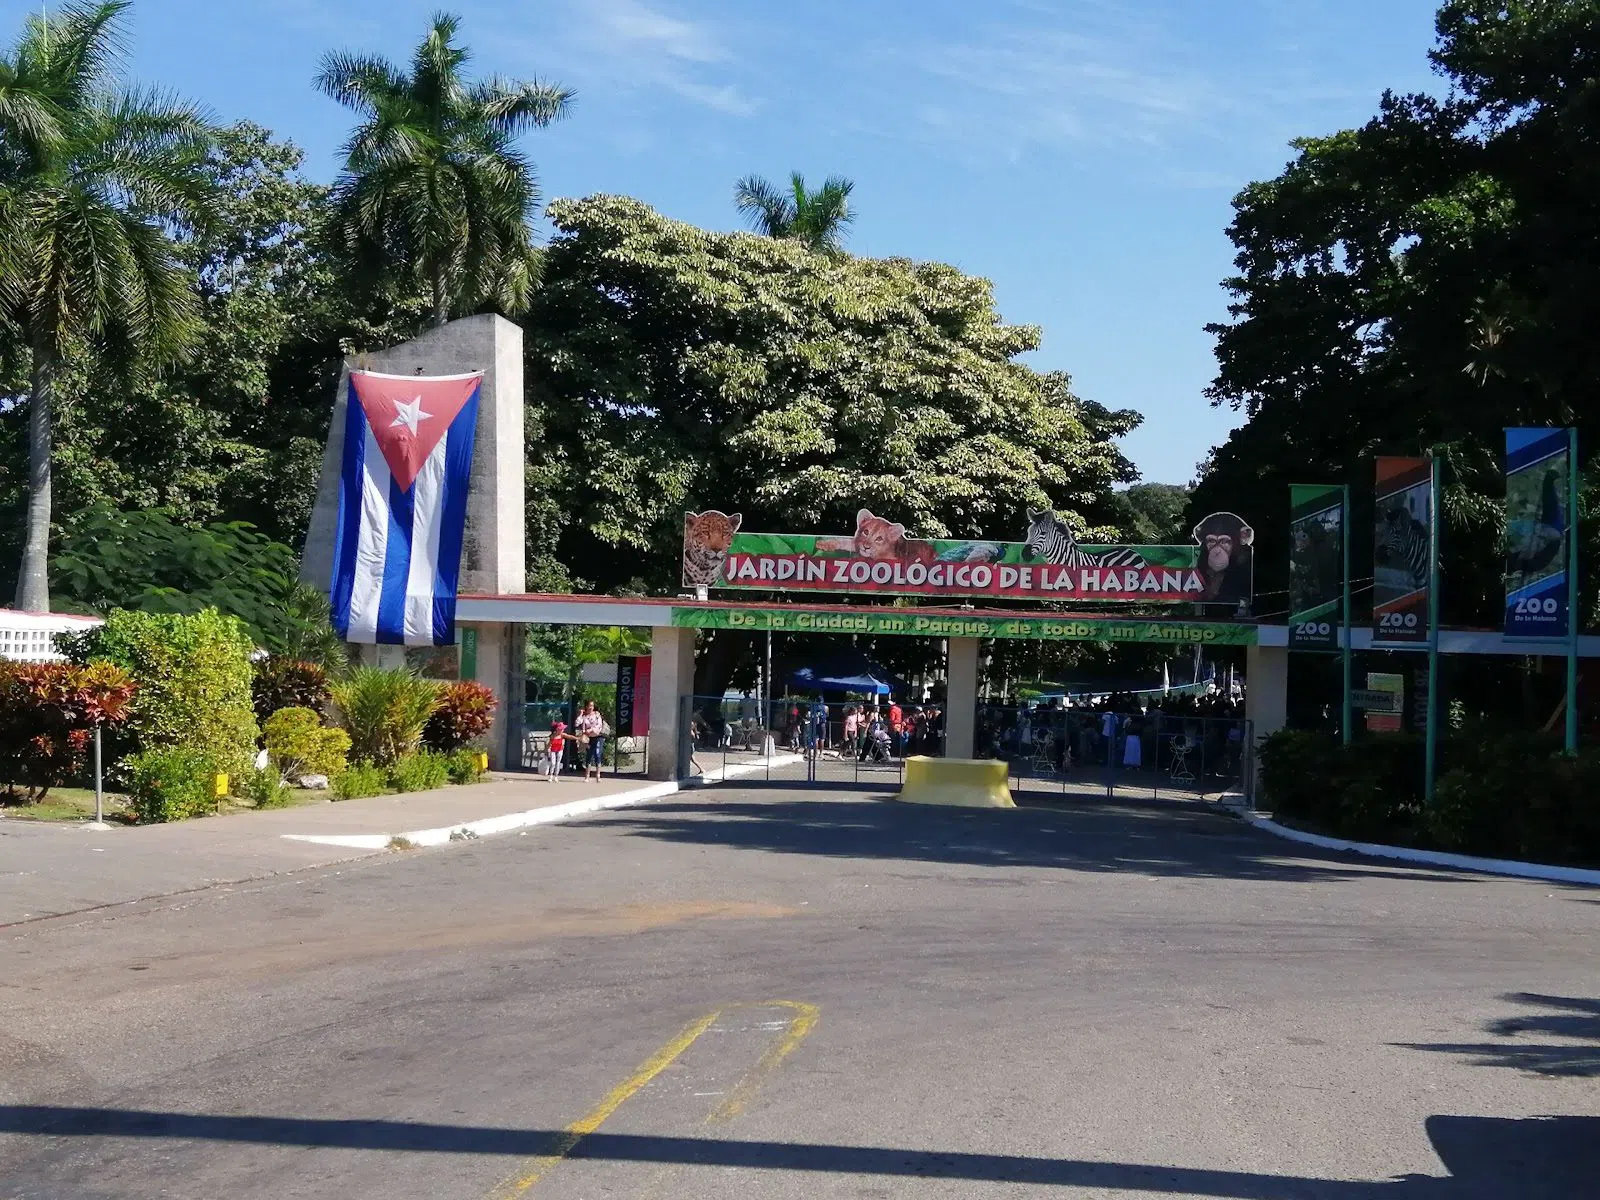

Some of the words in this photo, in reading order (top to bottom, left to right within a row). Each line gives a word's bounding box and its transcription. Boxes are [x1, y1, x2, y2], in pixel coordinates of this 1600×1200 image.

[727, 554, 826, 582] JARDÍN
[833, 557, 992, 589] ZOOLÓGICO
[1000, 567, 1033, 589] DE
[1040, 568, 1075, 591] LA
[1080, 569, 1205, 593] HABANA
[1515, 597, 1558, 614] ZOO
[729, 611, 756, 627] De
[766, 612, 785, 628] la
[796, 613, 874, 632] Ciudad,
[879, 617, 905, 631] un
[1006, 621, 1032, 635] de
[1043, 622, 1097, 638] todos
[1109, 625, 1136, 638] un
[1148, 623, 1217, 644] Amigo
[1295, 622, 1331, 636] ZOO
[1380, 612, 1418, 628] ZOO
[620, 666, 632, 725] MONCADA
